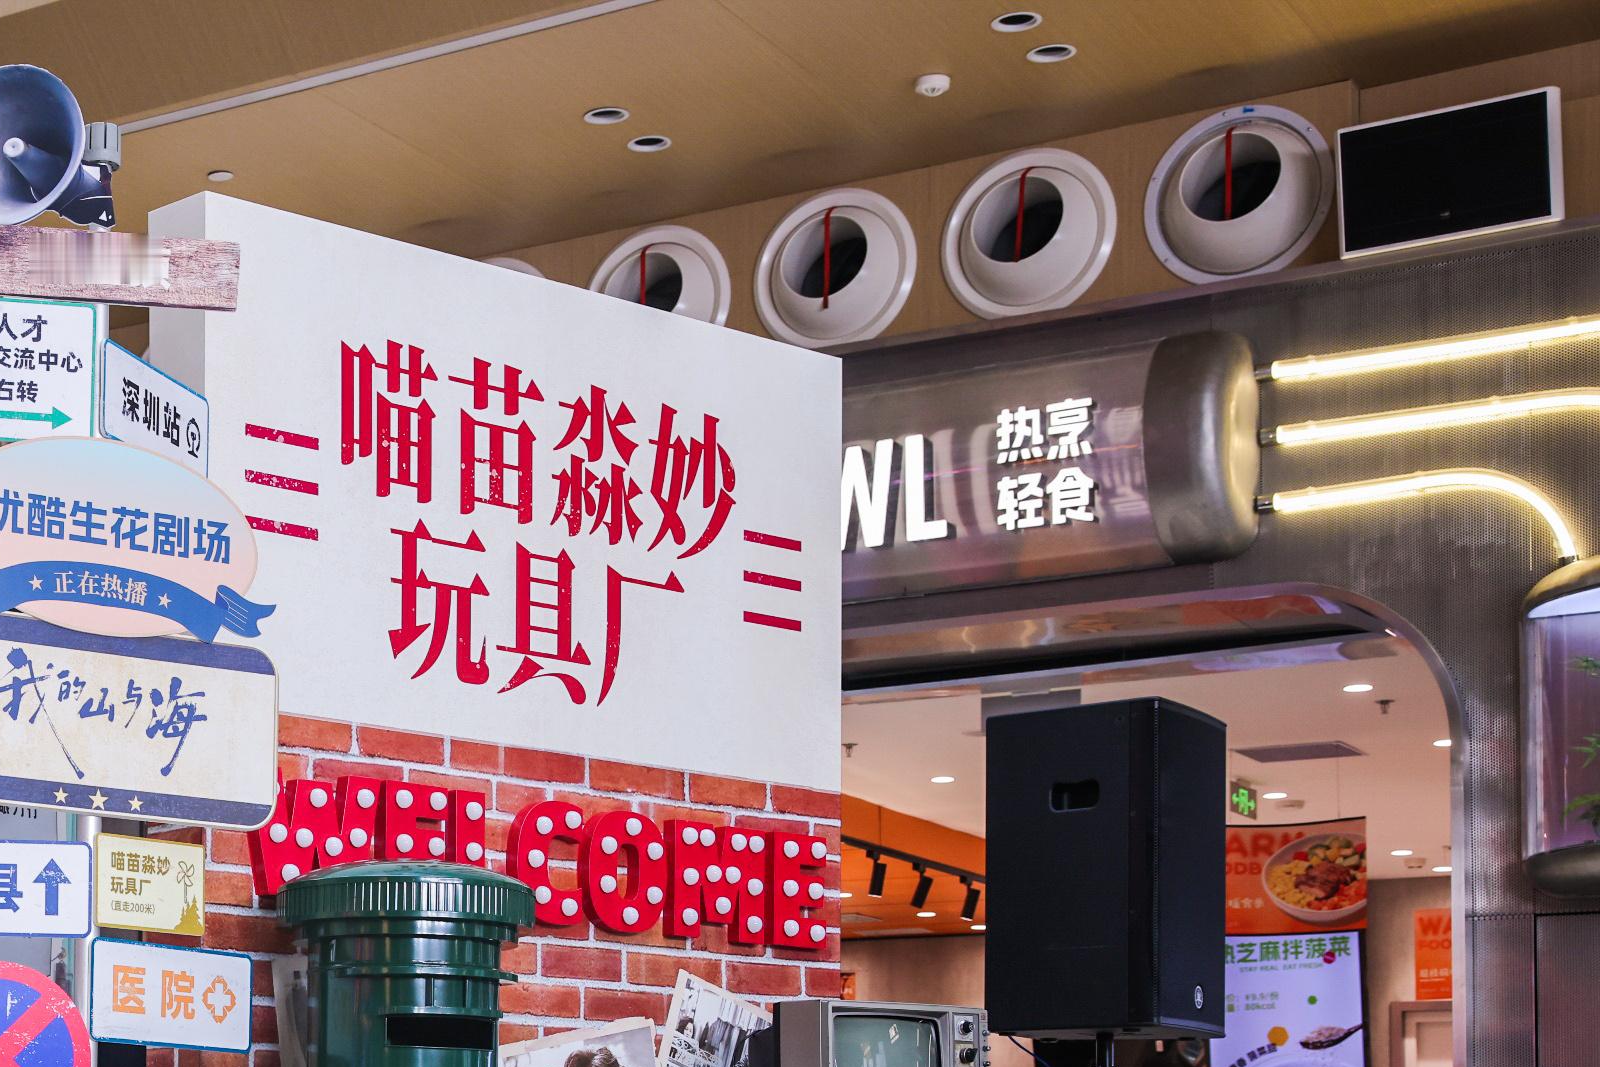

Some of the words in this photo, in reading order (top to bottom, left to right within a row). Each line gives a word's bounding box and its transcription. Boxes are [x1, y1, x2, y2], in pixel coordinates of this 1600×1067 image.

[121, 376, 181, 448] 深圳站
[996, 397, 1094, 465] 热烹
[340, 338, 737, 560] 喵苗淼妙
[996, 466, 1095, 531] 轻食
[52, 570, 149, 607] 正在热播
[387, 517, 686, 708] 玩具厂
[110, 851, 171, 876] 喵苗淼妙
[110, 876, 152, 896] 玩具厂
[112, 964, 196, 1020] 医院
